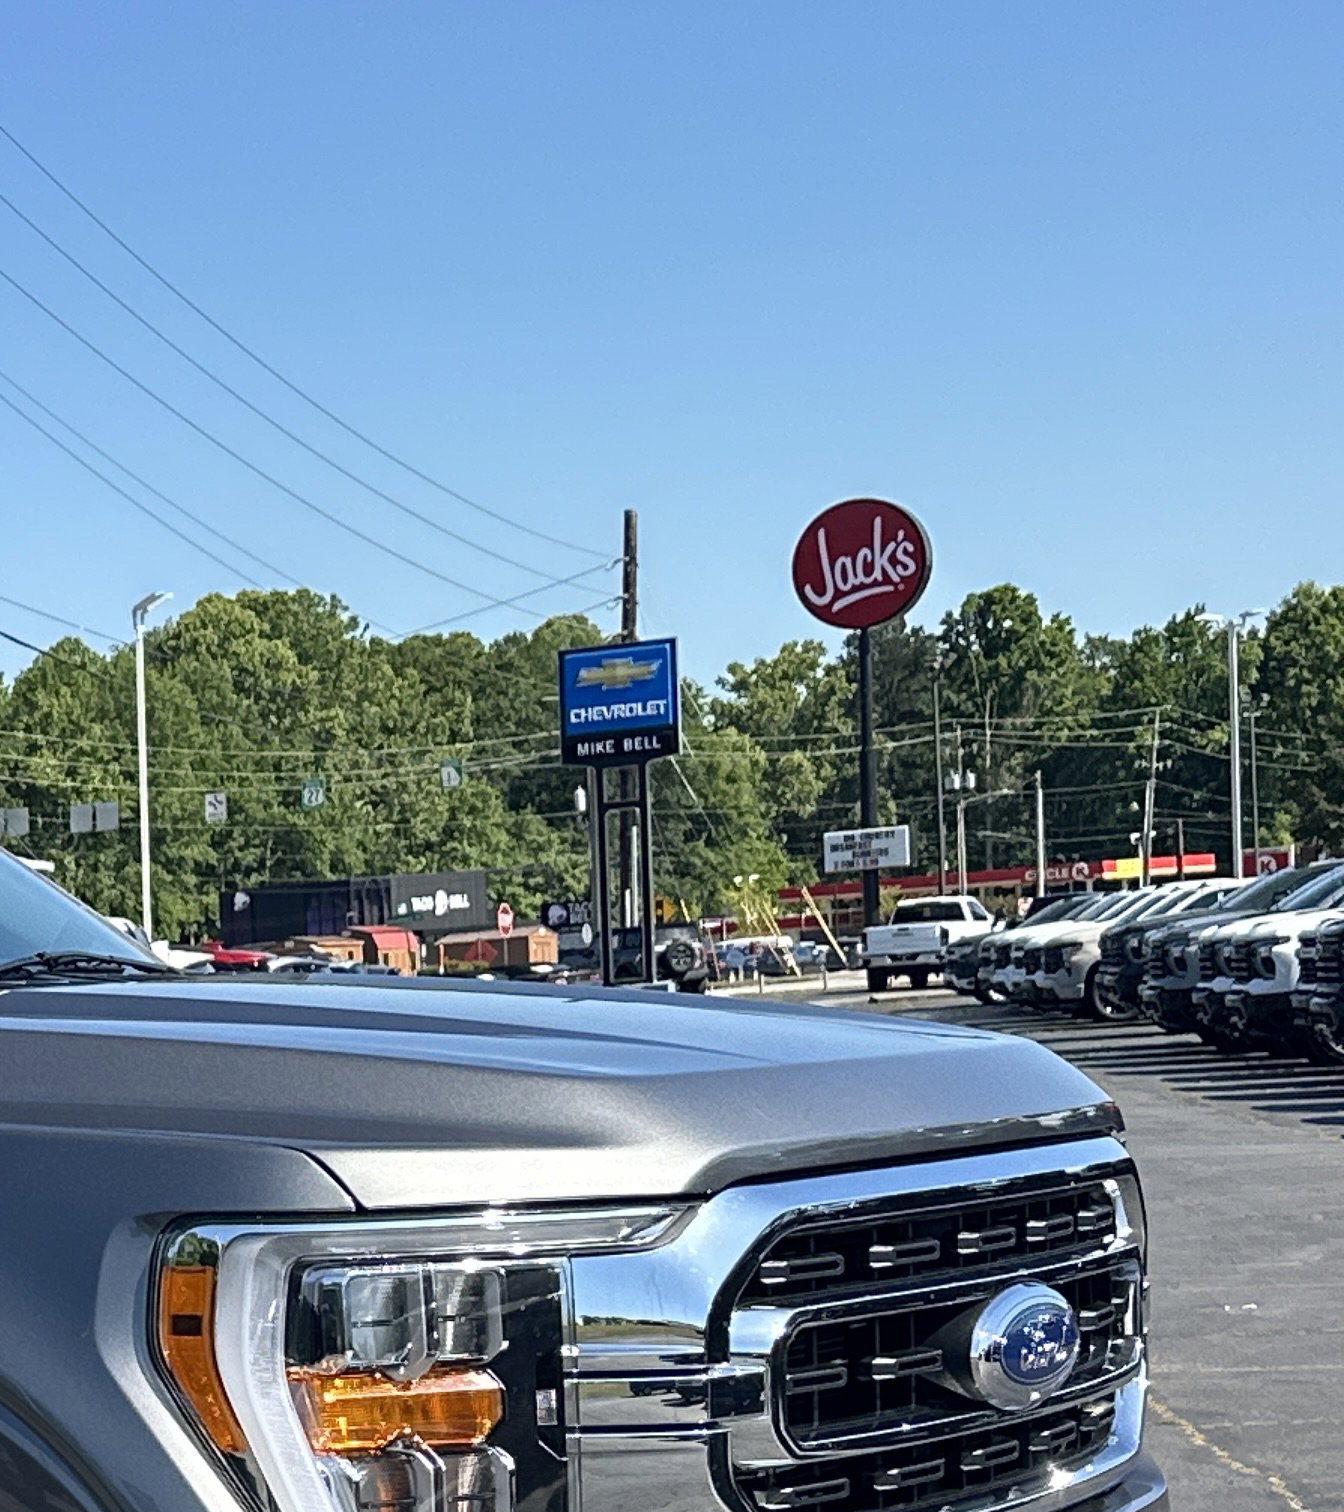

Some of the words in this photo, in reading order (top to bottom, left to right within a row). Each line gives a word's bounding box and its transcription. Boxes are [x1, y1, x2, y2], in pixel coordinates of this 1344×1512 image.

[803, 515, 917, 606] Jack's
[570, 699, 667, 723] CHEVROLET
[577, 739, 615, 756] MIKE
[623, 736, 661, 752] BELL
[307, 789, 320, 804] 27
